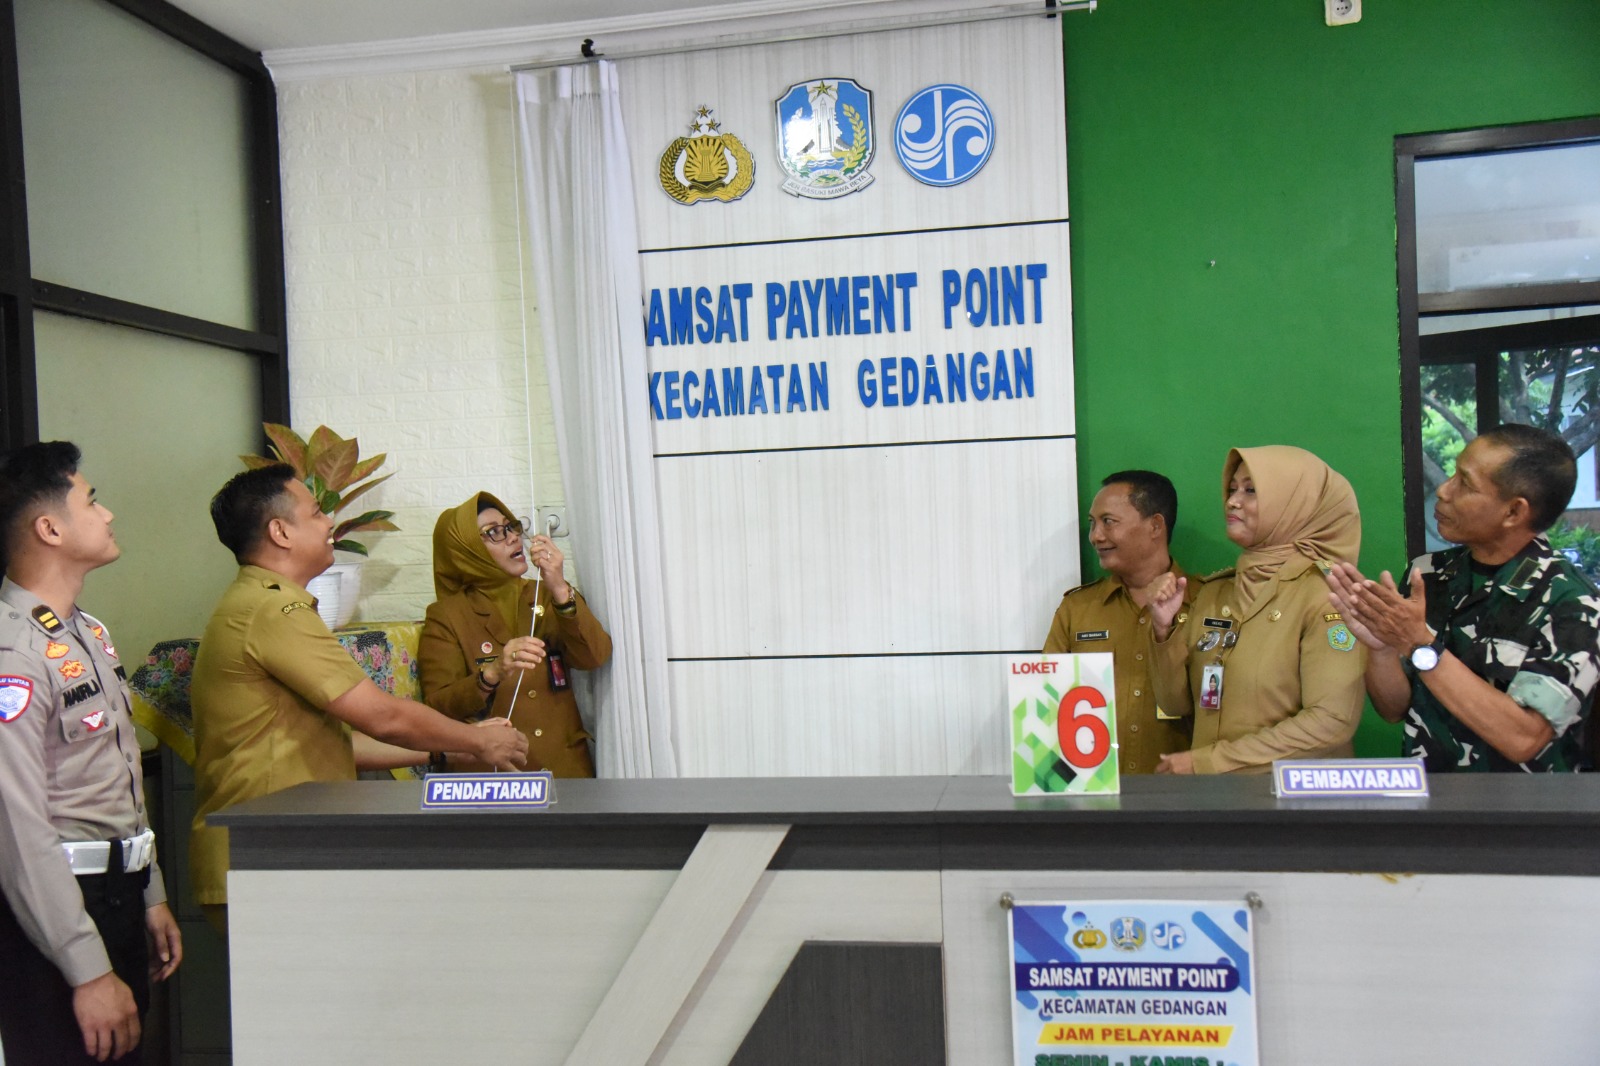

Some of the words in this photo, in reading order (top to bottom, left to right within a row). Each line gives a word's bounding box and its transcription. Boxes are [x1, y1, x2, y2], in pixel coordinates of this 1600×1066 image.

[801, 185, 827, 196] BASUKI
[828, 185, 849, 195] MAWA
[850, 174, 867, 188] BEYA
[642, 283, 753, 346] AMSAT
[766, 271, 918, 341] PAYMENT
[943, 263, 1048, 329] POINT
[648, 361, 830, 420] KECAMATAN
[857, 347, 1035, 408] GEDANGAN
[1012, 661, 1058, 675] LOKET
[1057, 686, 1111, 769] 6
[1288, 769, 1418, 789] PEMBAYARAN
[432, 781, 543, 801] PENDAFTARAN
[1029, 967, 1092, 987] SAMSAT
[1097, 967, 1174, 988] PAYMENT
[1177, 968, 1229, 989] POINT
[1043, 998, 1136, 1015] KECAMATAN
[1141, 999, 1227, 1016] GEDANGAN
[1054, 1027, 1094, 1042] JAM
[1101, 1027, 1220, 1043] PELAYANAN
